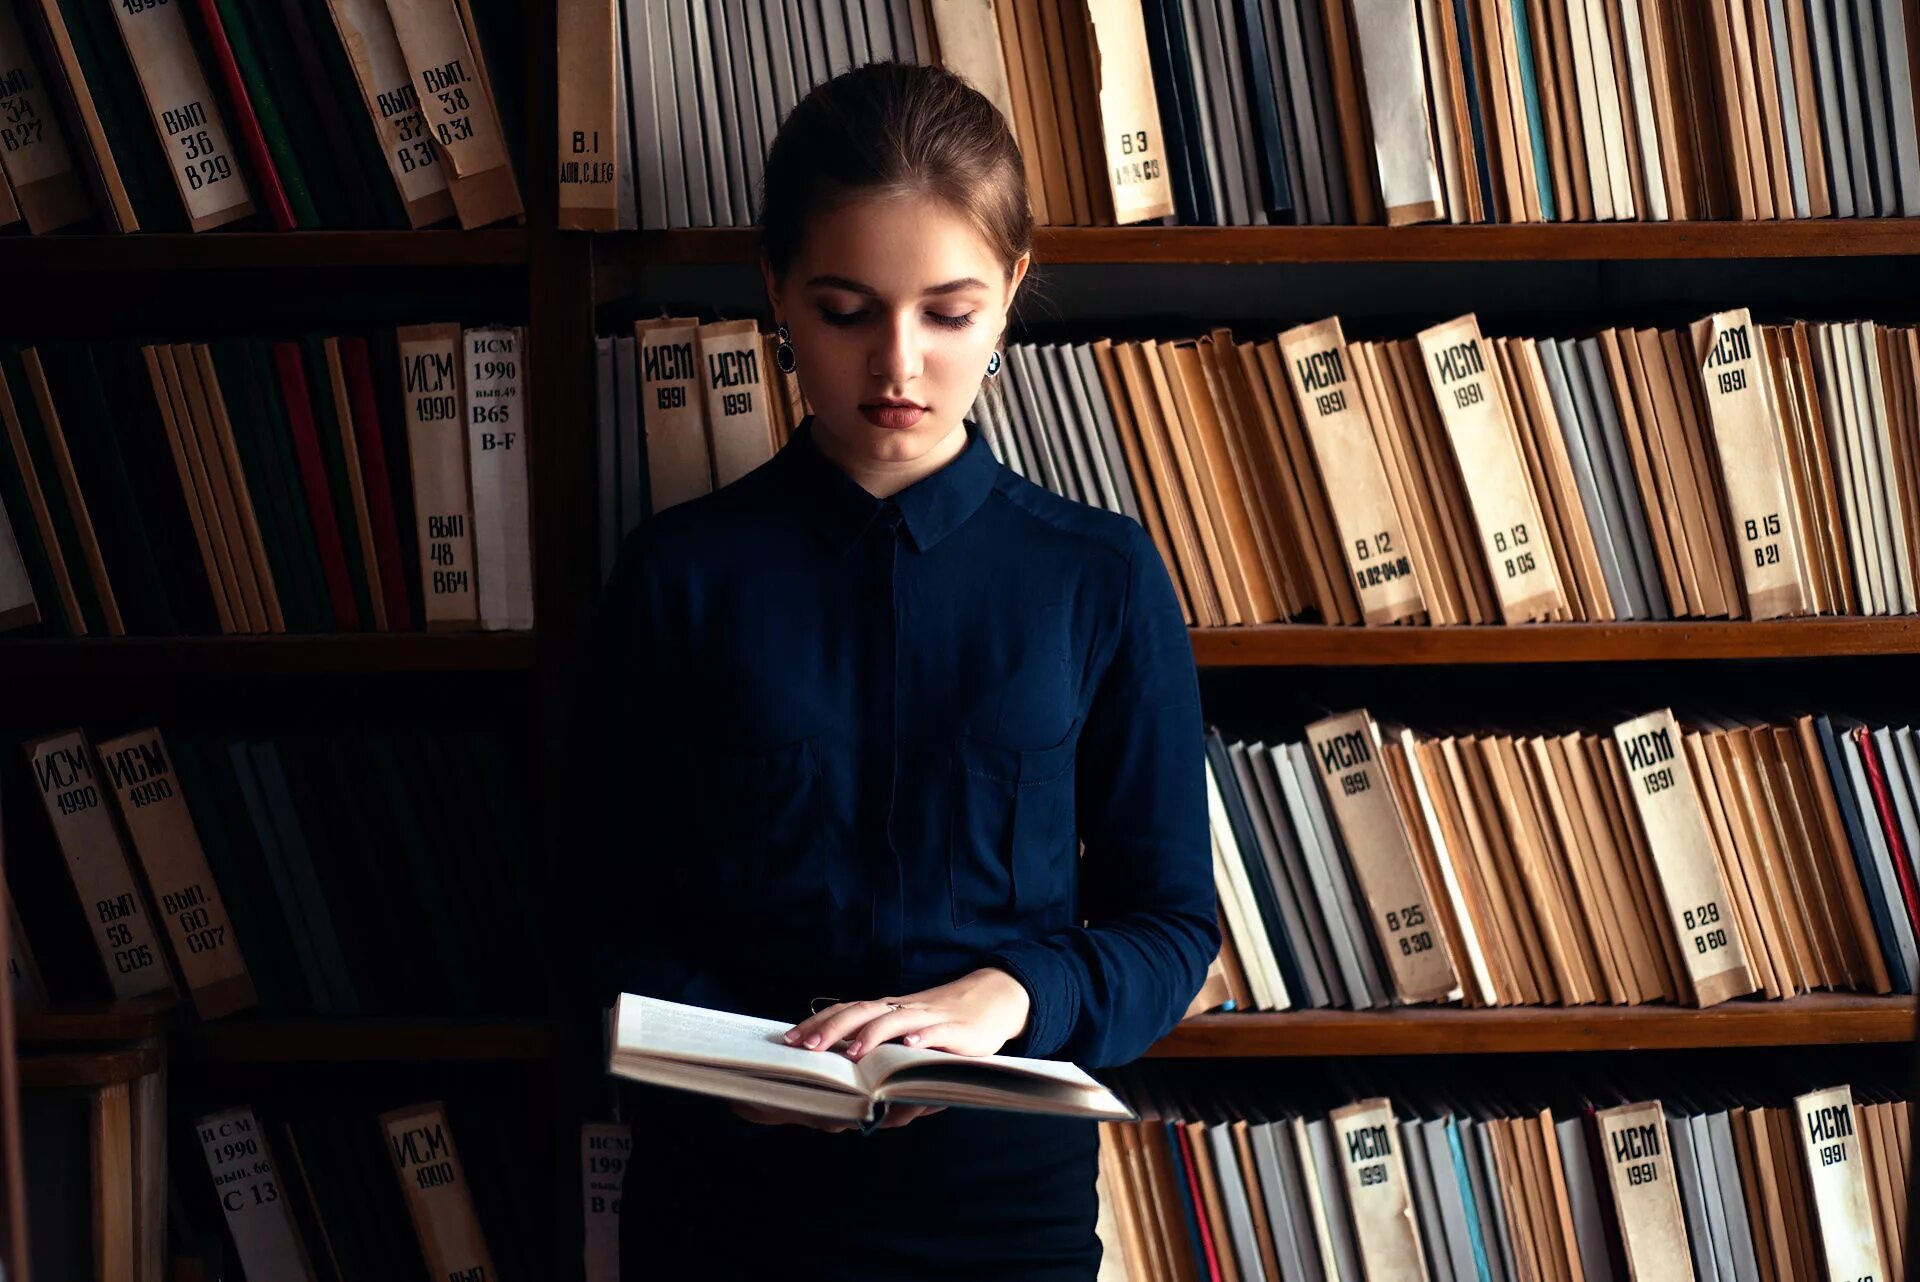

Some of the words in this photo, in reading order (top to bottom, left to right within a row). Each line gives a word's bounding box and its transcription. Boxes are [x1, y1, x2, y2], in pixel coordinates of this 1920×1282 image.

[437, 88, 470, 115] 38
[162, 101, 207, 136] ВЫП
[395, 111, 424, 142] 37
[181, 130, 214, 160] 36
[473, 339, 512, 354] ИСМ
[405, 352, 455, 393] ИСМ
[474, 361, 516, 380] 1990
[643, 342, 695, 382] ИСМ
[708, 349, 759, 389] ИСМ
[1296, 347, 1346, 393] ИСМ
[1435, 338, 1485, 385] ИСМ
[1717, 368, 1747, 394] 1991
[416, 395, 456, 421] 1990
[657, 386, 686, 410] 1991
[722, 392, 753, 416] 1991
[1315, 390, 1347, 416] 1991
[1453, 382, 1484, 409] 1991
[472, 405, 509, 424] B65
[481, 432, 516, 451] B-F
[428, 515, 464, 538] ВЫП
[430, 543, 454, 566] 48
[1317, 730, 1371, 774] ИСМ
[1624, 726, 1675, 771] ИСМ
[34, 745, 92, 793] ИСМ
[106, 741, 168, 789] ИСМ
[131, 778, 173, 808] 1990
[1340, 770, 1371, 797] 1991
[1642, 767, 1675, 795] 1991
[57, 785, 98, 815] 1990
[96, 893, 137, 923] ВЫП
[180, 907, 210, 933] 60
[106, 923, 133, 948] 58
[1807, 1103, 1853, 1144] ИСМ
[214, 1138, 257, 1164] 1990
[392, 1124, 450, 1168] ИСМ
[1346, 1124, 1392, 1163] ИСМ
[1611, 1123, 1660, 1164] ИСМ
[1819, 1142, 1847, 1167] 1991
[416, 1162, 455, 1189] 1990
[591, 1157, 622, 1174] 199
[1358, 1163, 1388, 1187] 1991
[1626, 1162, 1658, 1187] 1991
